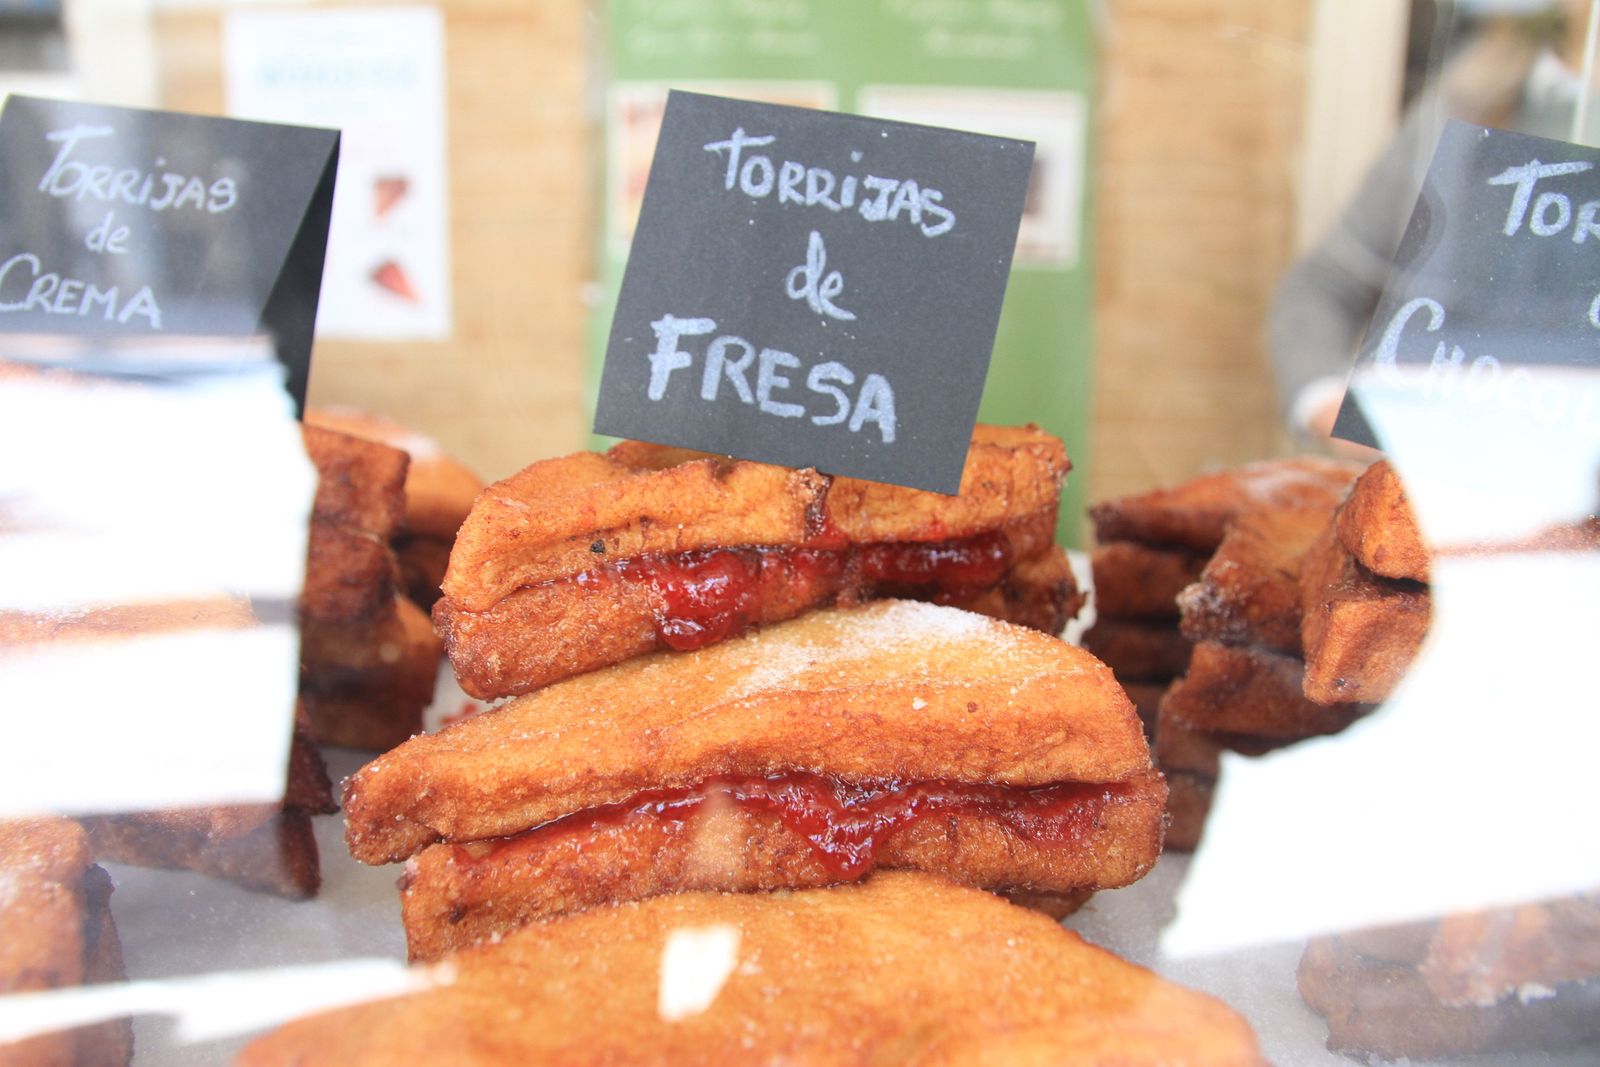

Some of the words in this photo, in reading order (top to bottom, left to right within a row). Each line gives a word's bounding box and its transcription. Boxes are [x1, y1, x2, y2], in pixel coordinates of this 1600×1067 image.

[84, 210, 131, 254] de
[0, 253, 163, 330] CREMA
[785, 230, 858, 321] de
[647, 313, 897, 444] FRESA
